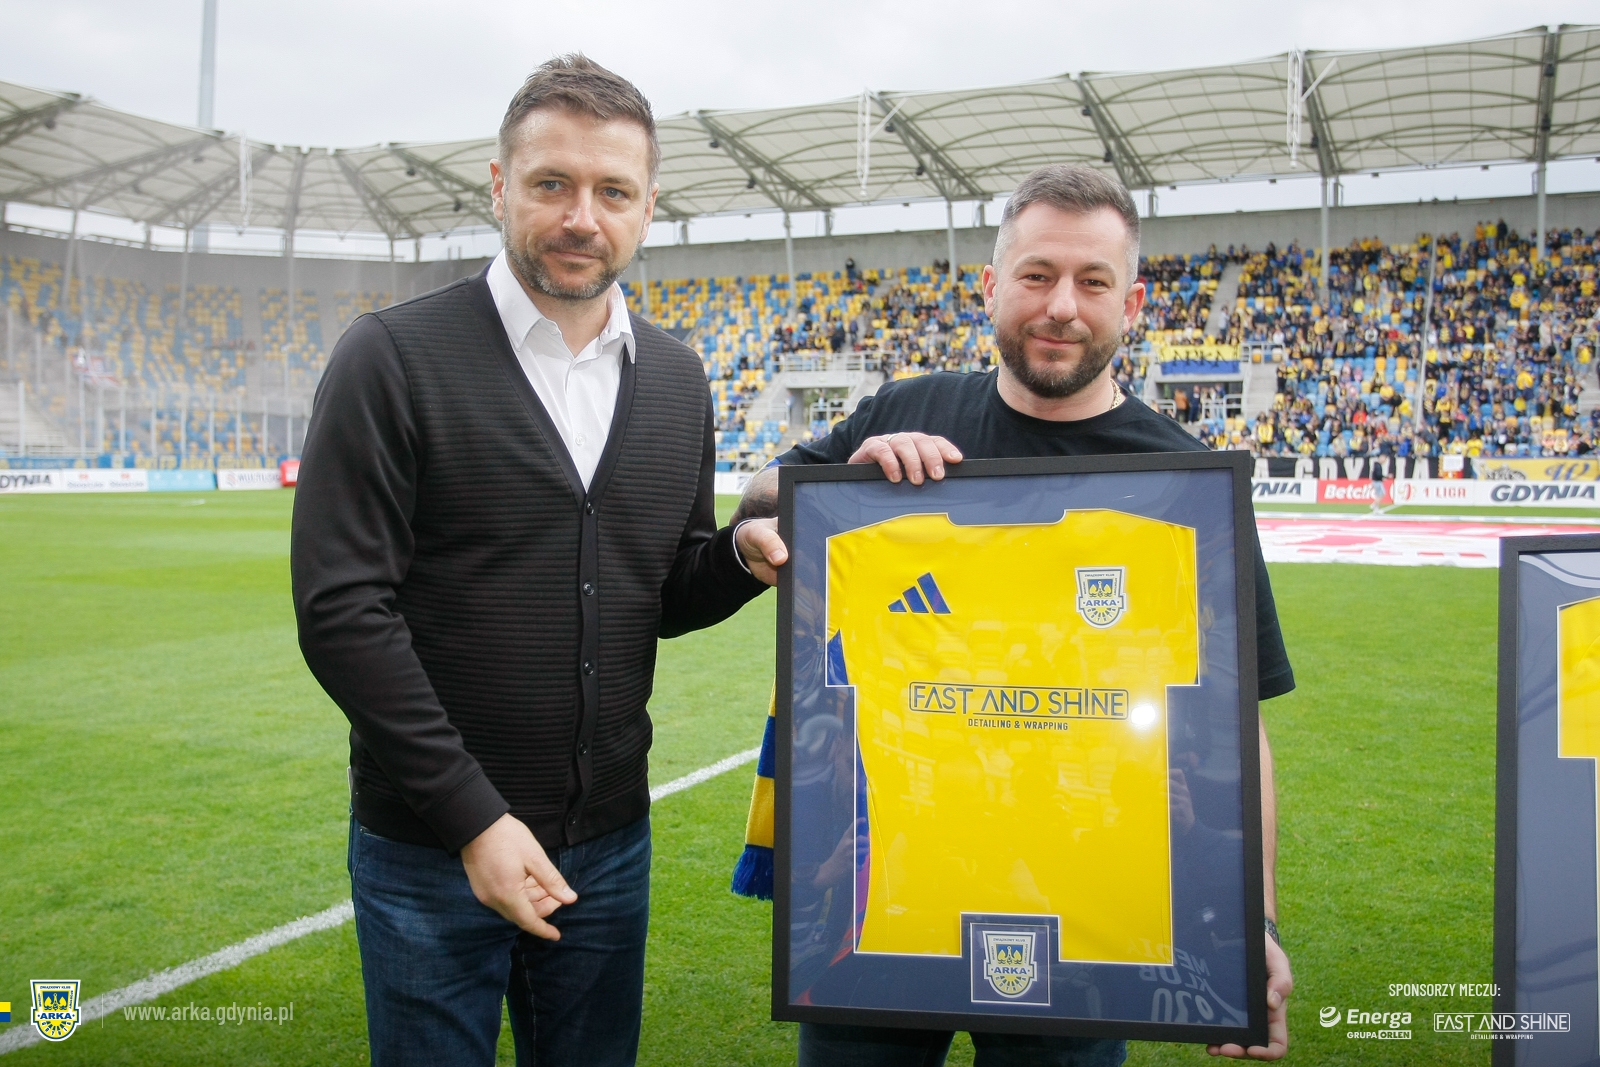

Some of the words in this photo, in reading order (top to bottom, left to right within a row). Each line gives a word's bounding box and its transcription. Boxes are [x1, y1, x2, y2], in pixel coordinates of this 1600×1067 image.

[0, 475, 51, 488] DYNIA
[1252, 483, 1301, 496] YNIA
[1490, 484, 1595, 502] GDYNIA
[1085, 599, 1117, 607] ARKA
[913, 685, 973, 714] FAST
[980, 689, 1039, 713] AND
[1047, 688, 1124, 716] SHINE
[968, 718, 1011, 729] DETAILING
[1013, 720, 1021, 729] &
[1023, 720, 1069, 731] WRAPPING
[993, 966, 1028, 975] ARKA
